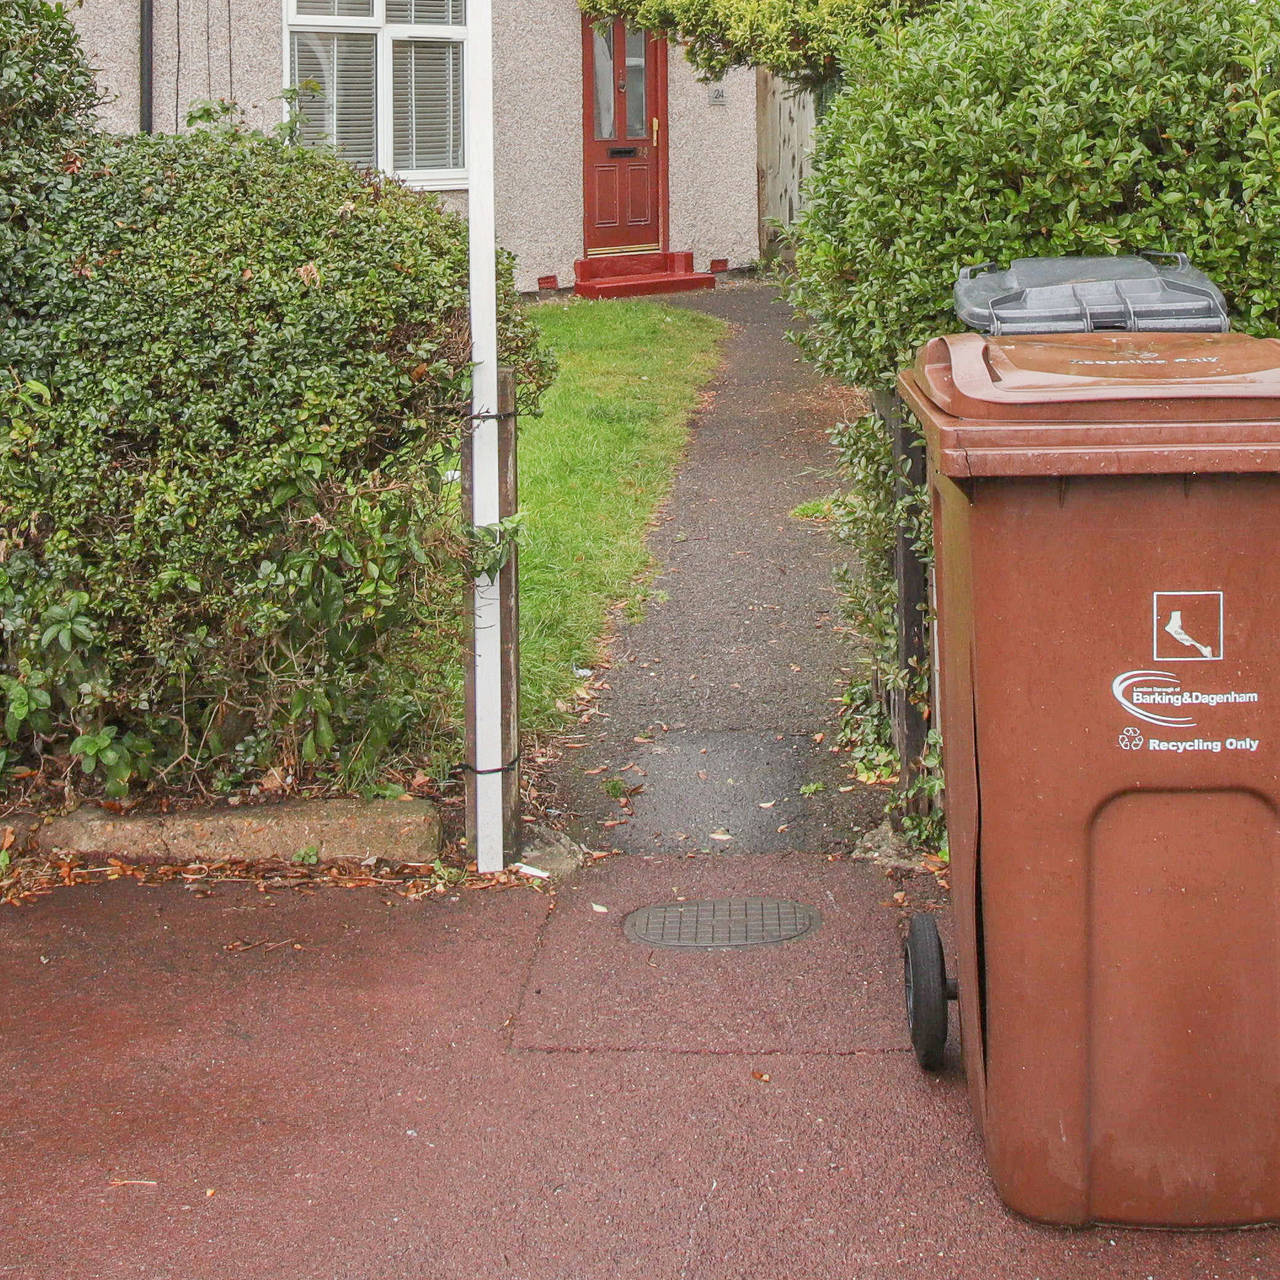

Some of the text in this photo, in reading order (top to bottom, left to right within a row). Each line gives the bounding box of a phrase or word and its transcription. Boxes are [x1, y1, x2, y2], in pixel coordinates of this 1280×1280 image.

[1133, 692, 1258, 705] Barking&Dagenham
[1149, 737, 1259, 752] Recycling Only
